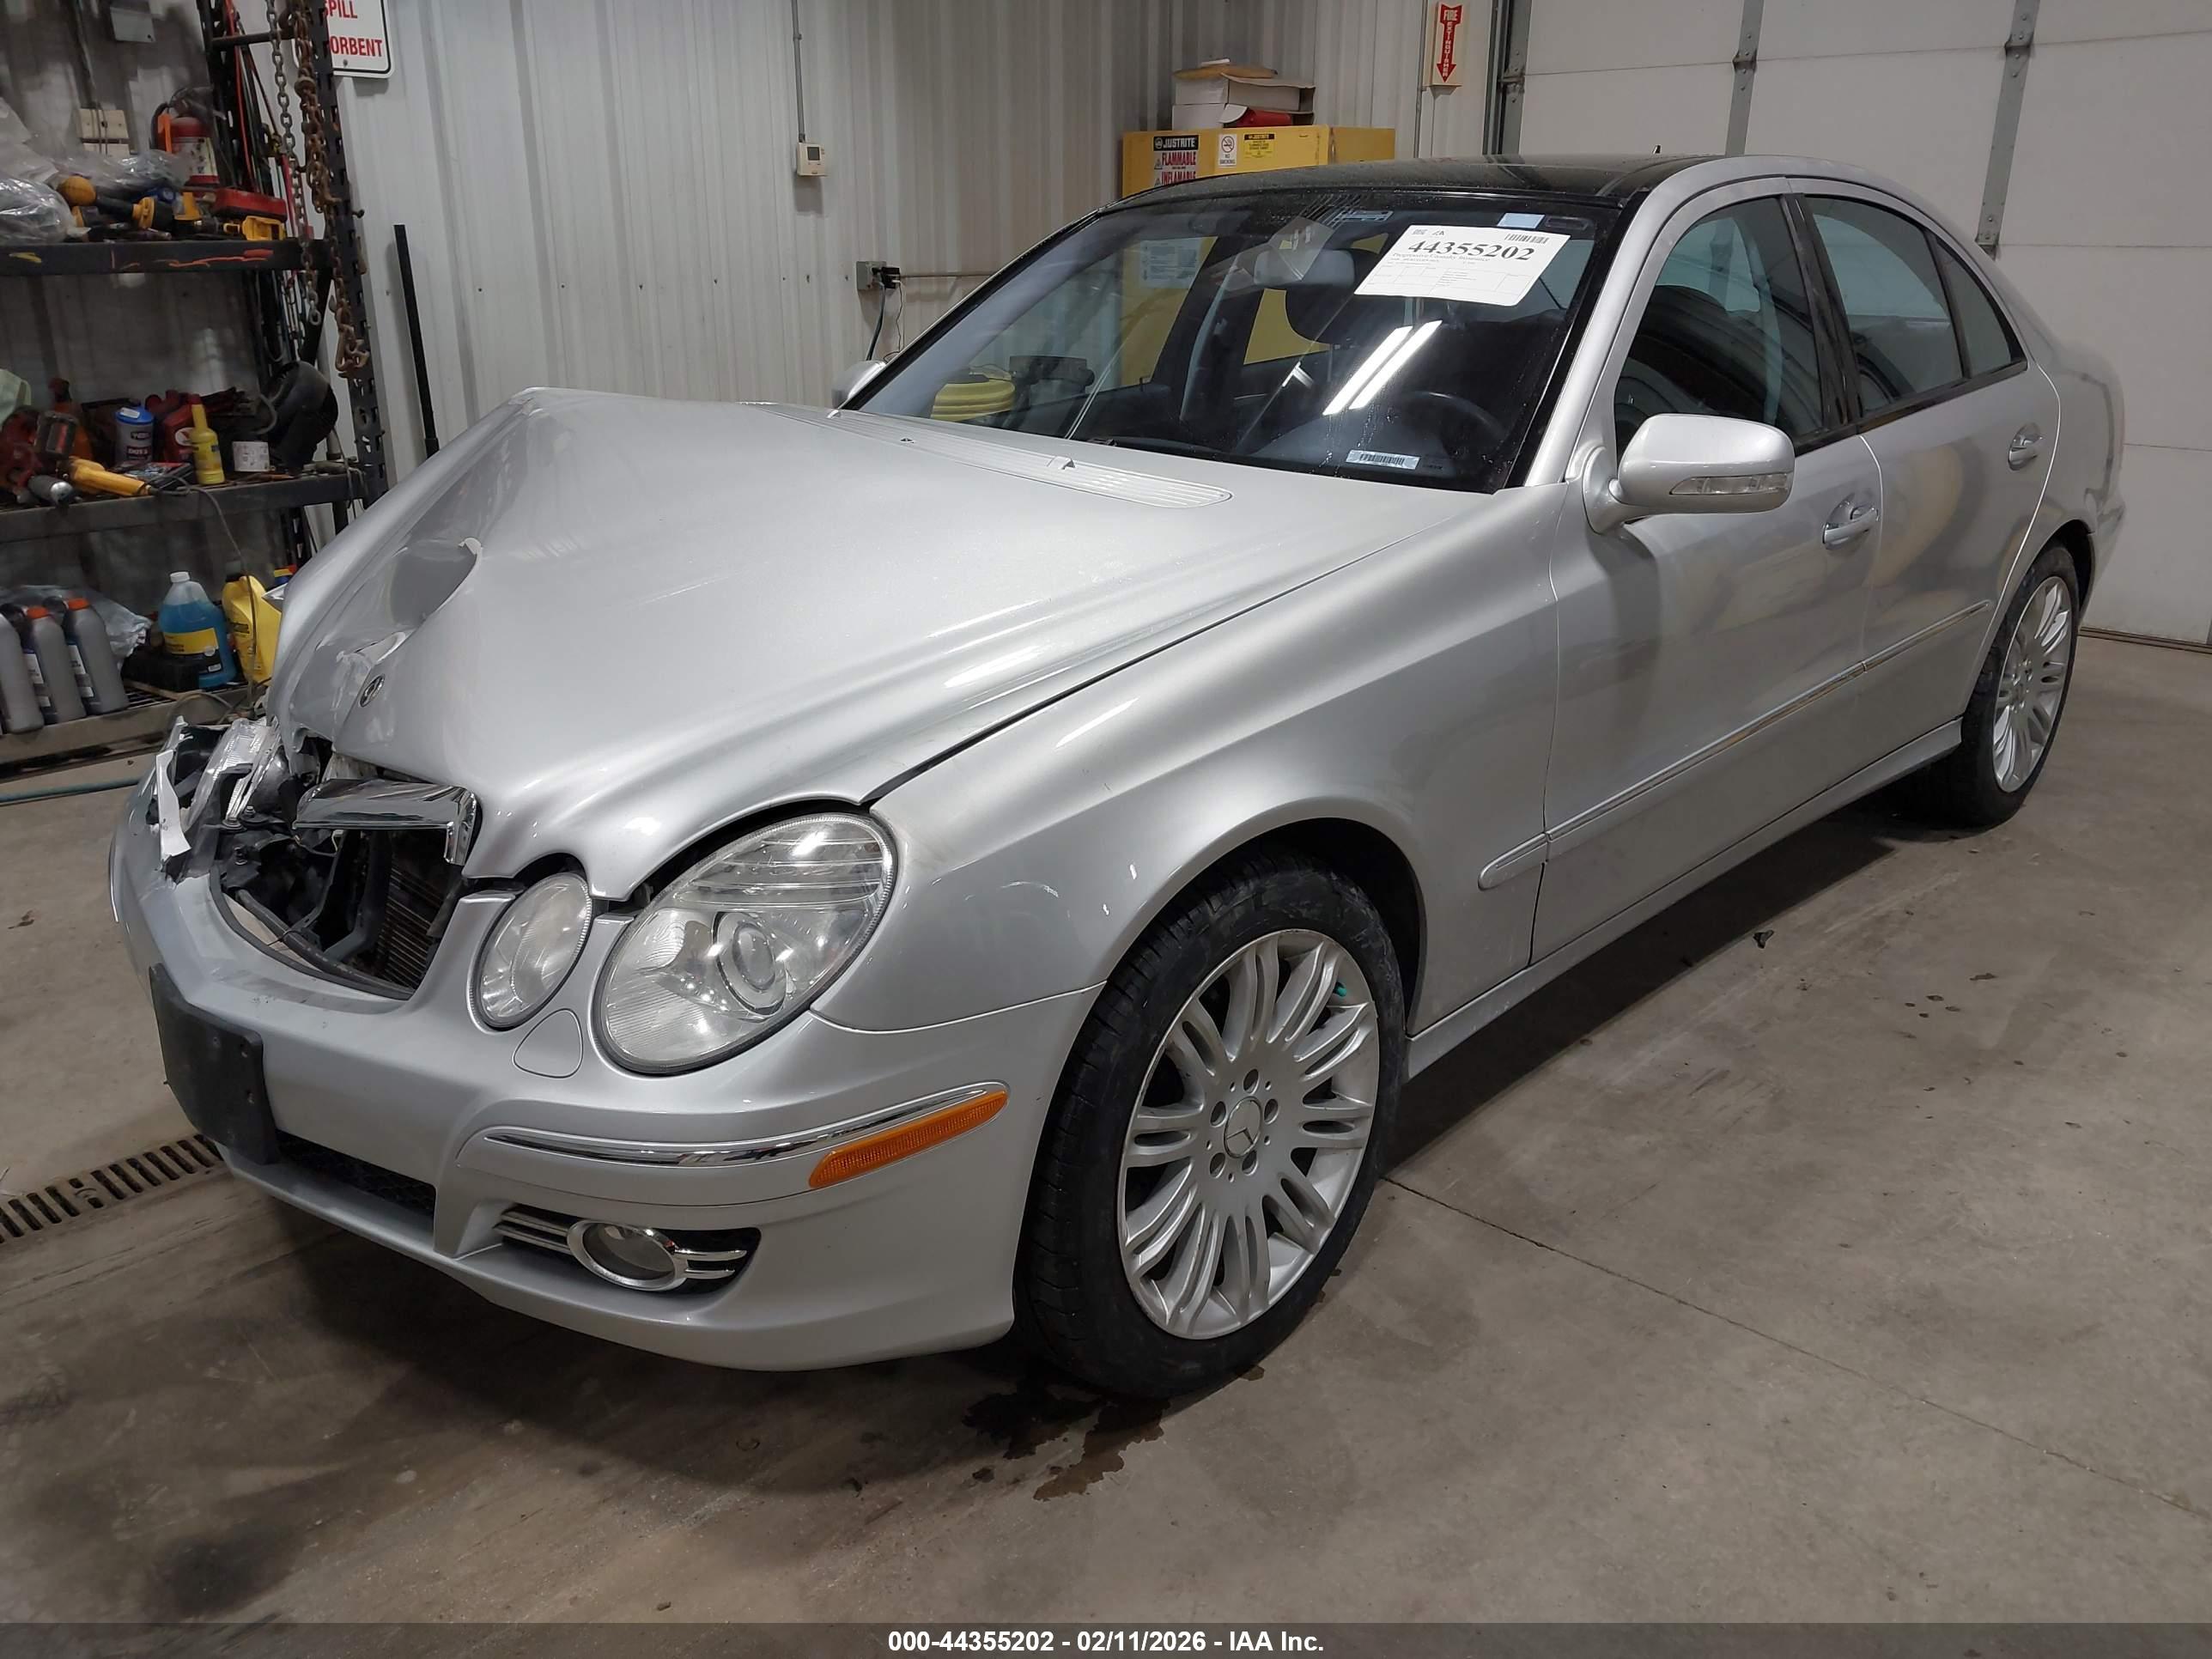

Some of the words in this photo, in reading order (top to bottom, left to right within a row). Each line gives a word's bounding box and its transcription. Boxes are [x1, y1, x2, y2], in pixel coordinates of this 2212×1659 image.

[1443, 9, 1458, 21] FIRE
[1443, 21, 1453, 77] EXTINGUISHER
[1163, 137, 1195, 149] JUSTRITE
[1161, 151, 1196, 166] FLAMMABLE
[1408, 240, 1535, 260] 44355202
